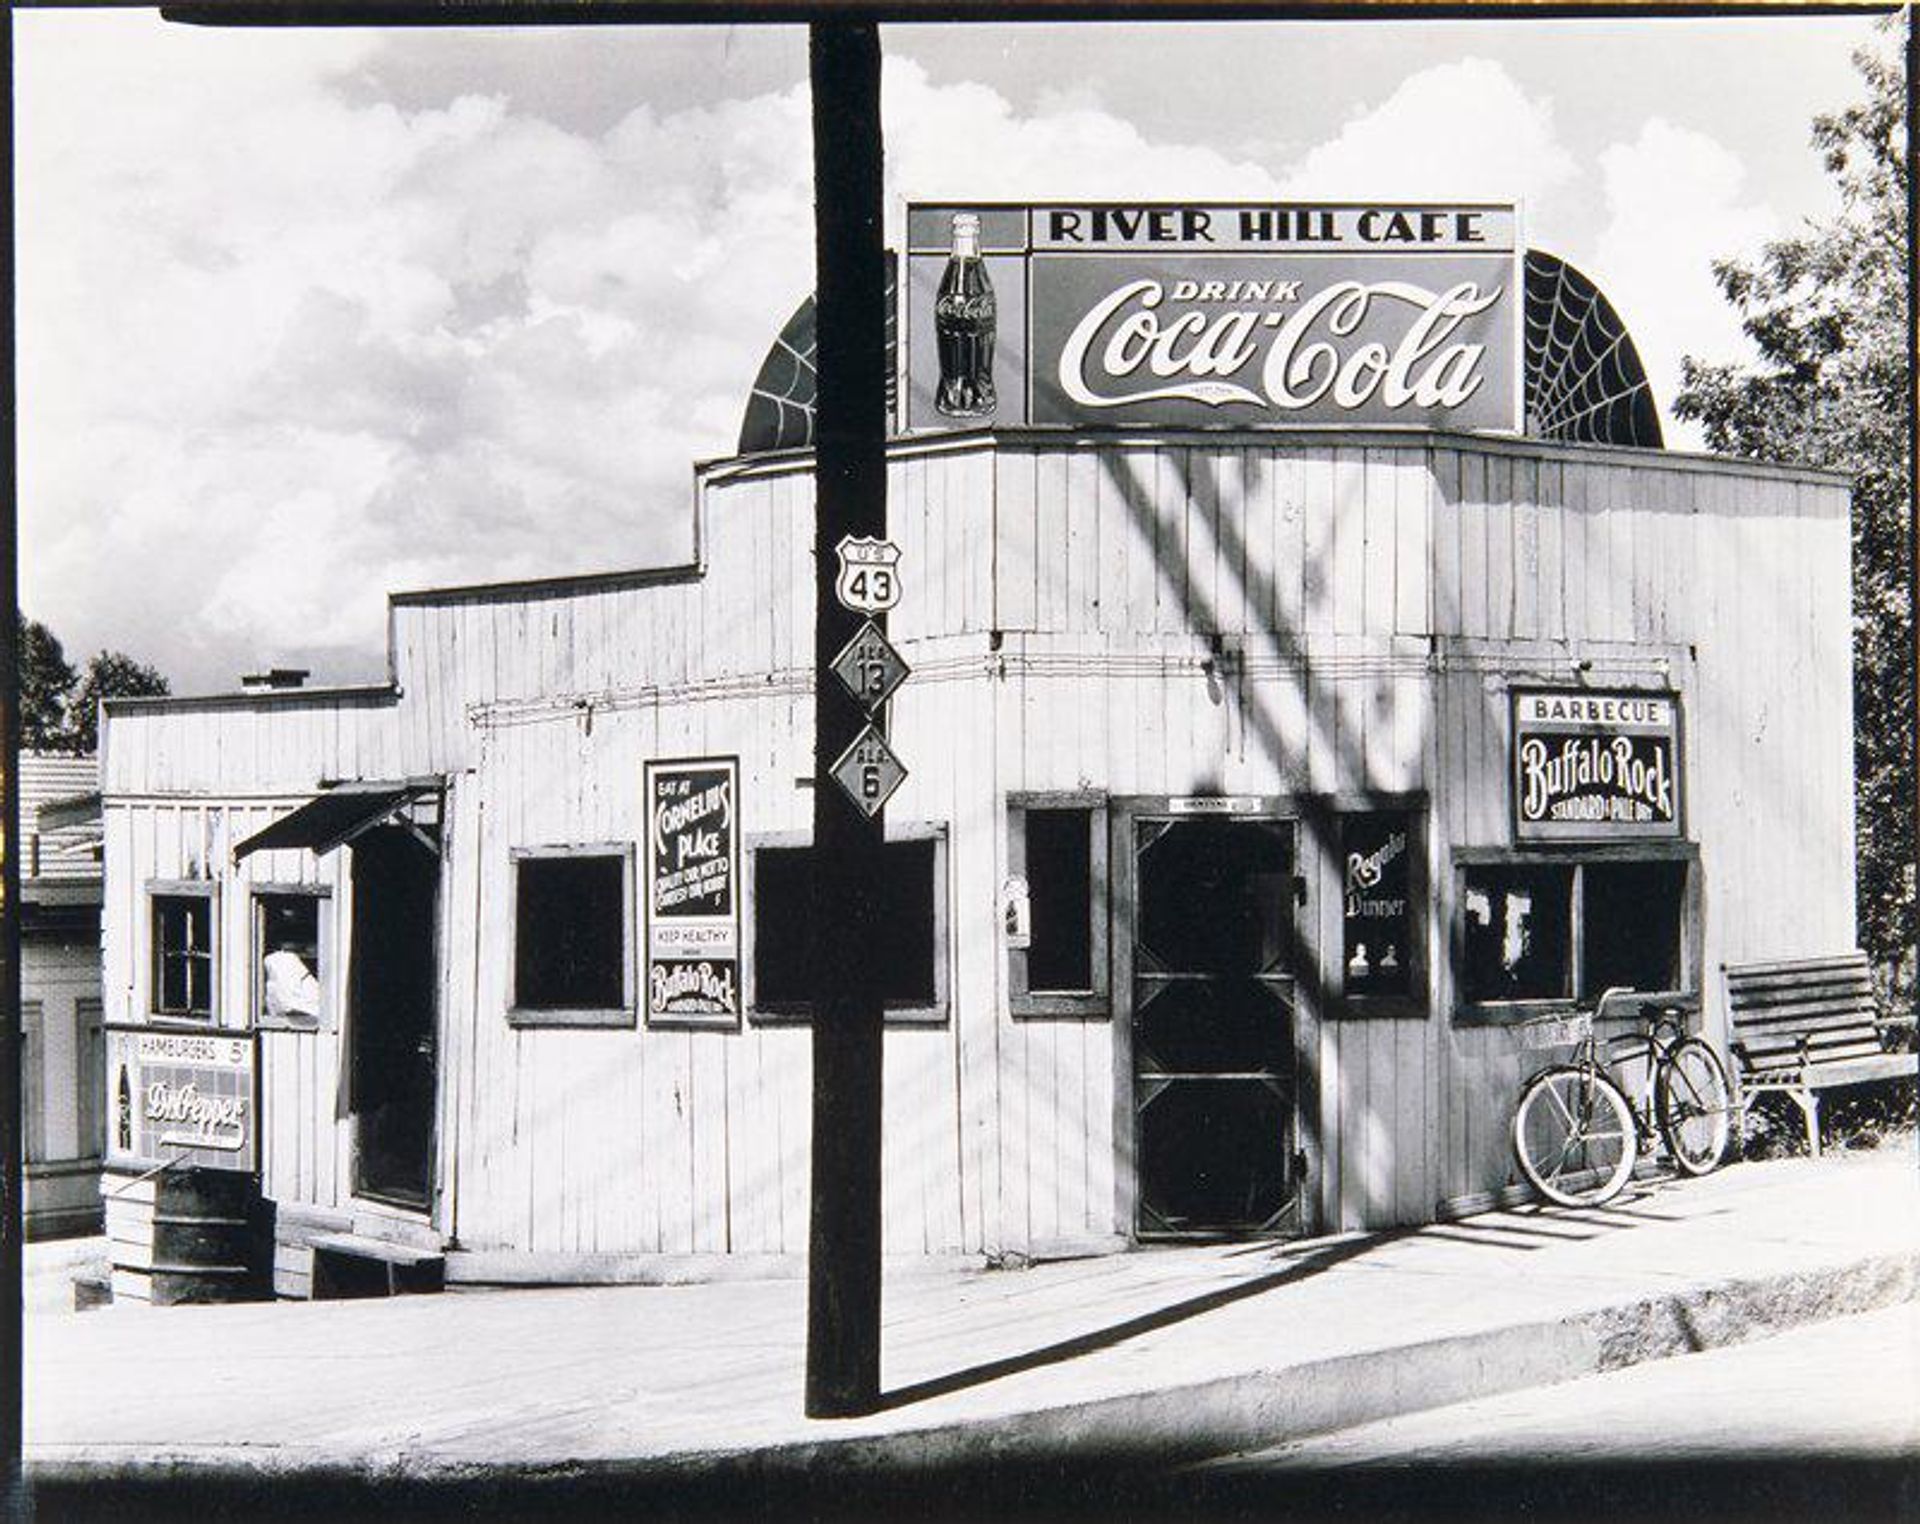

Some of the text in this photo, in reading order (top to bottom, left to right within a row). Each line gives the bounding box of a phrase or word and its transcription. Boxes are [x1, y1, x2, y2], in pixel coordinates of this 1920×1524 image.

[1049, 211, 1486, 242] RIVER HILL CAFE
[1172, 281, 1303, 302] DRINK
[1058, 280, 1502, 409] Coca-Cola
[849, 570, 892, 602] 43
[859, 662, 885, 696] 13
[1535, 700, 1659, 721] BARBECUE
[658, 781, 677, 796] EAT
[863, 766, 880, 799] 6
[1522, 736, 1672, 819] Buffalo Rock
[678, 827, 719, 869] PLACE
[682, 929, 729, 943] HEALTHY
[651, 962, 735, 1012] Buffalo Rock
[142, 1038, 216, 1060] HAMBURGERS
